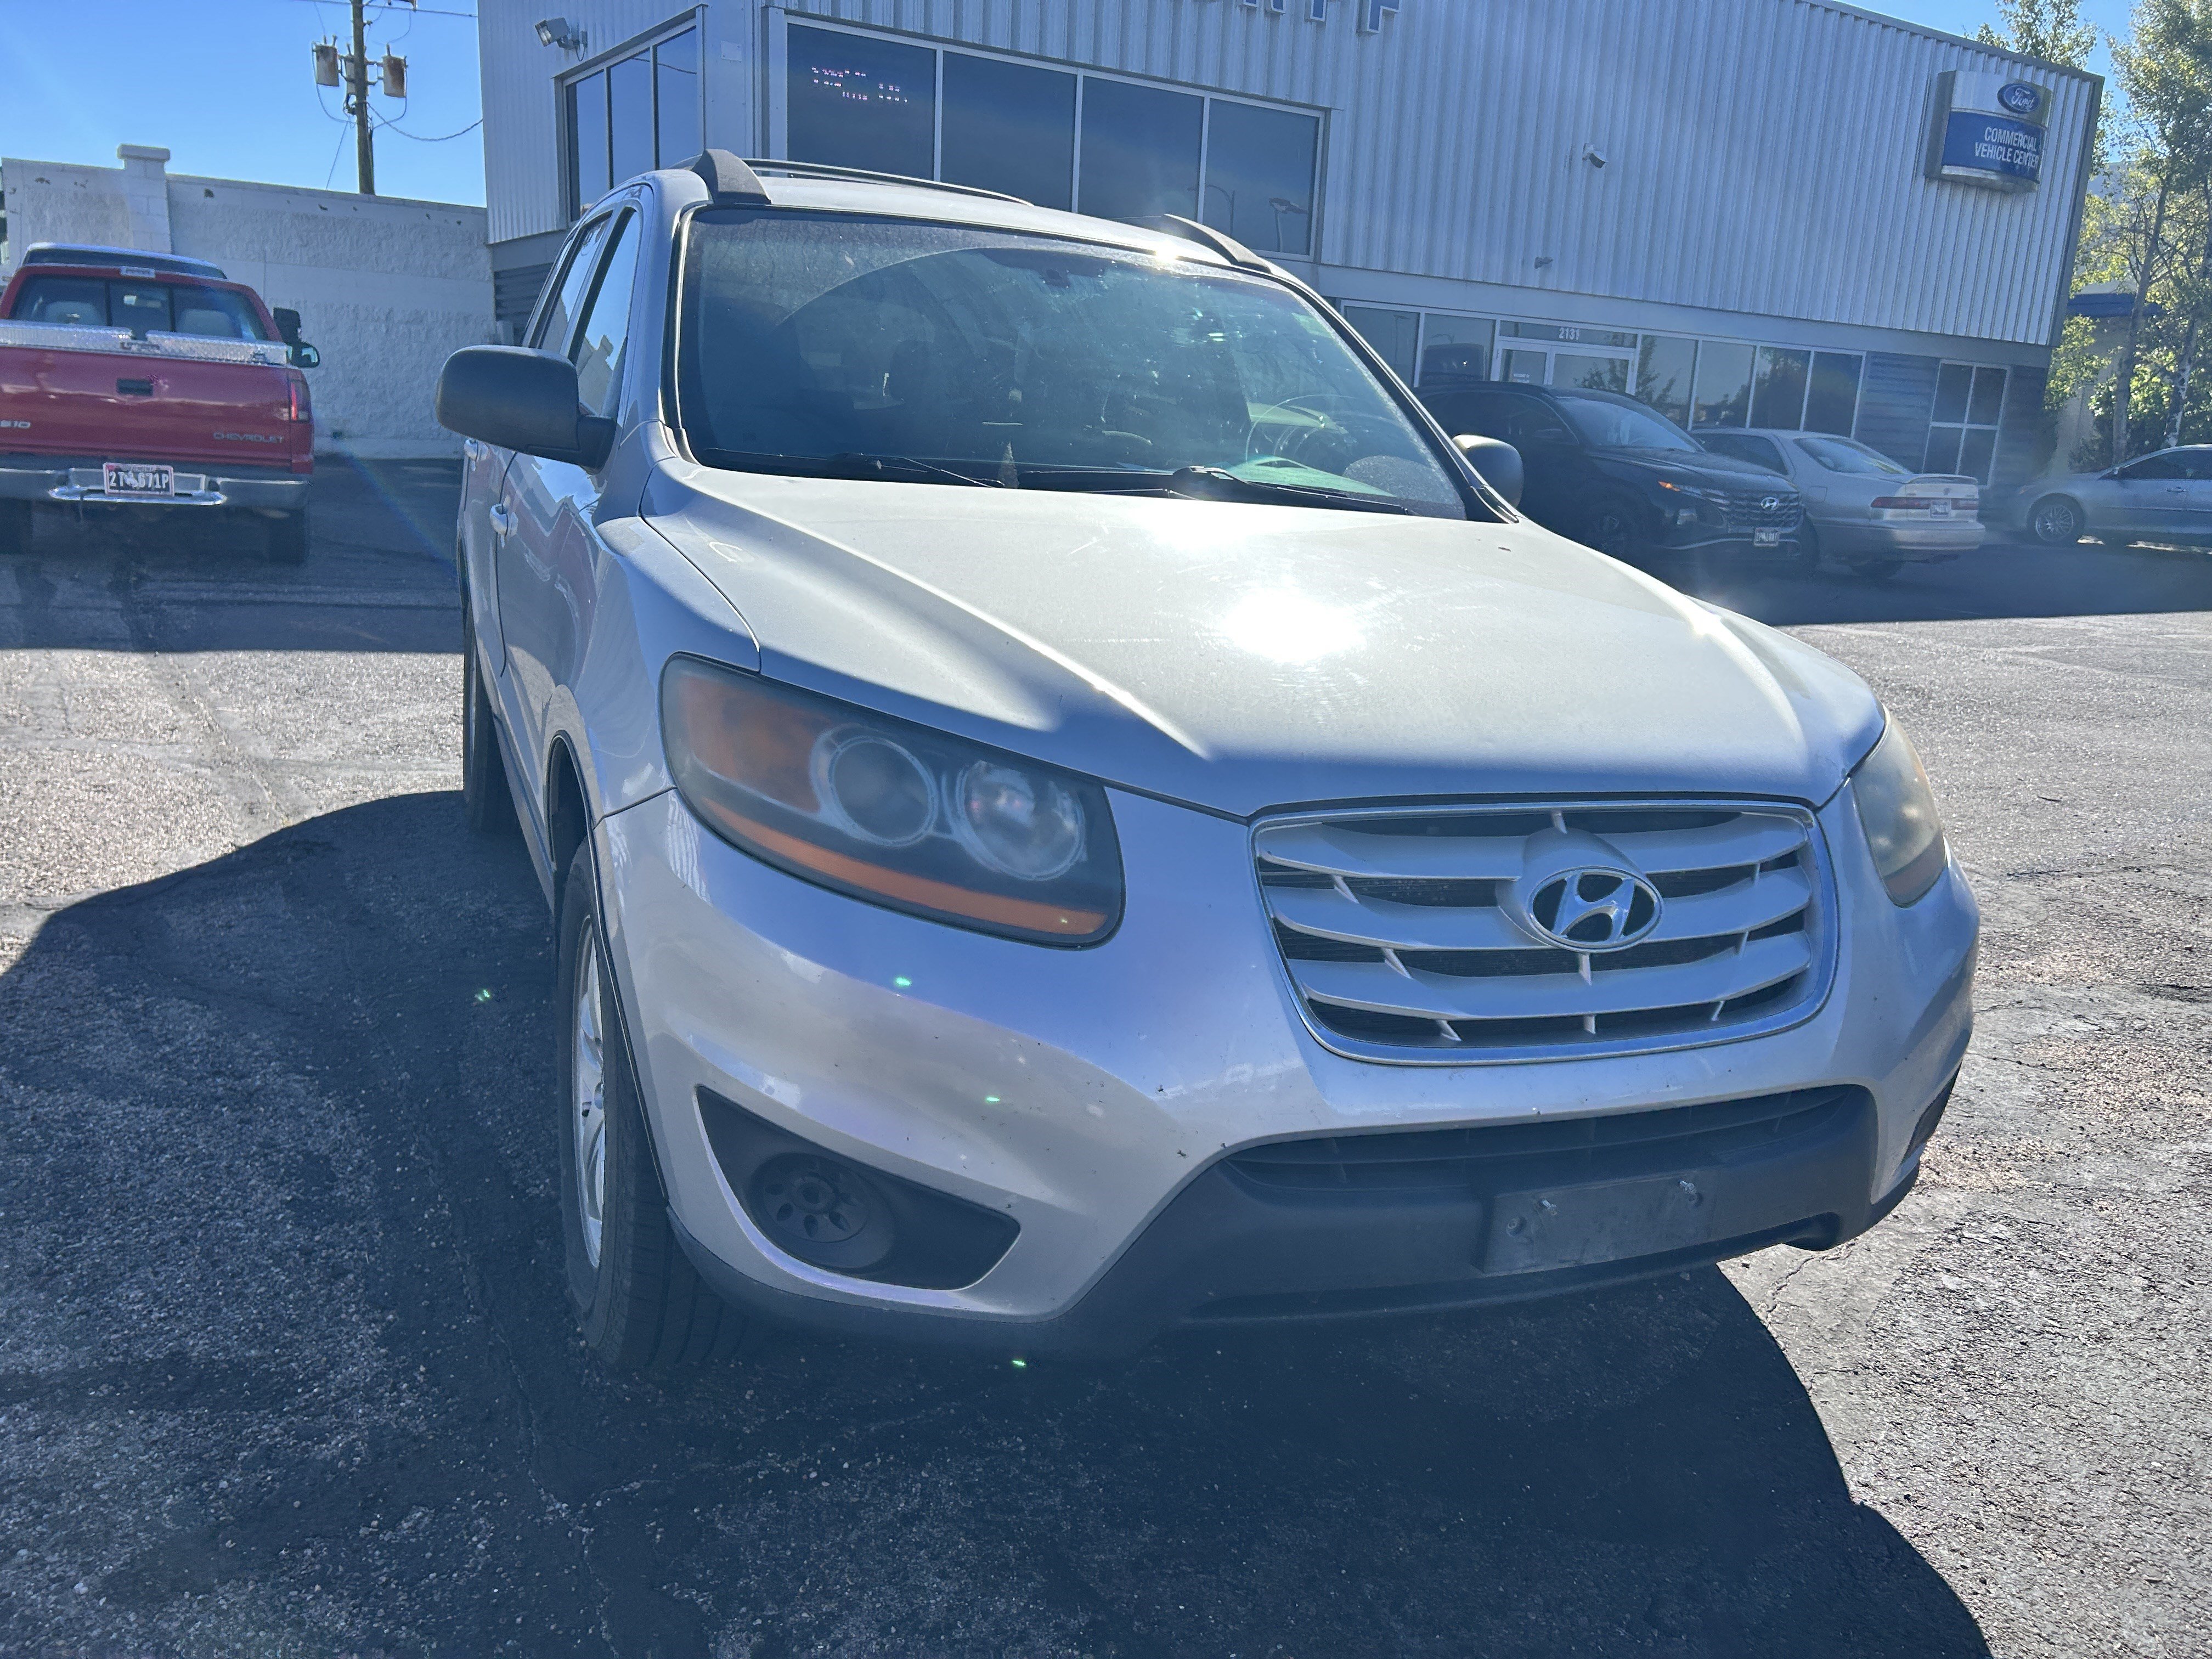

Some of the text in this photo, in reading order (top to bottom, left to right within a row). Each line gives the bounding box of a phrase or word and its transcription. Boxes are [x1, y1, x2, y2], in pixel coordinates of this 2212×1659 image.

[2010, 87, 2035, 110] Ford
[1984, 126, 2037, 153] COMMERCIAL
[1974, 142, 2039, 167] VEHICLE CENTER
[1559, 327, 1580, 341] 2131
[213, 431, 284, 443] CHEVROLET
